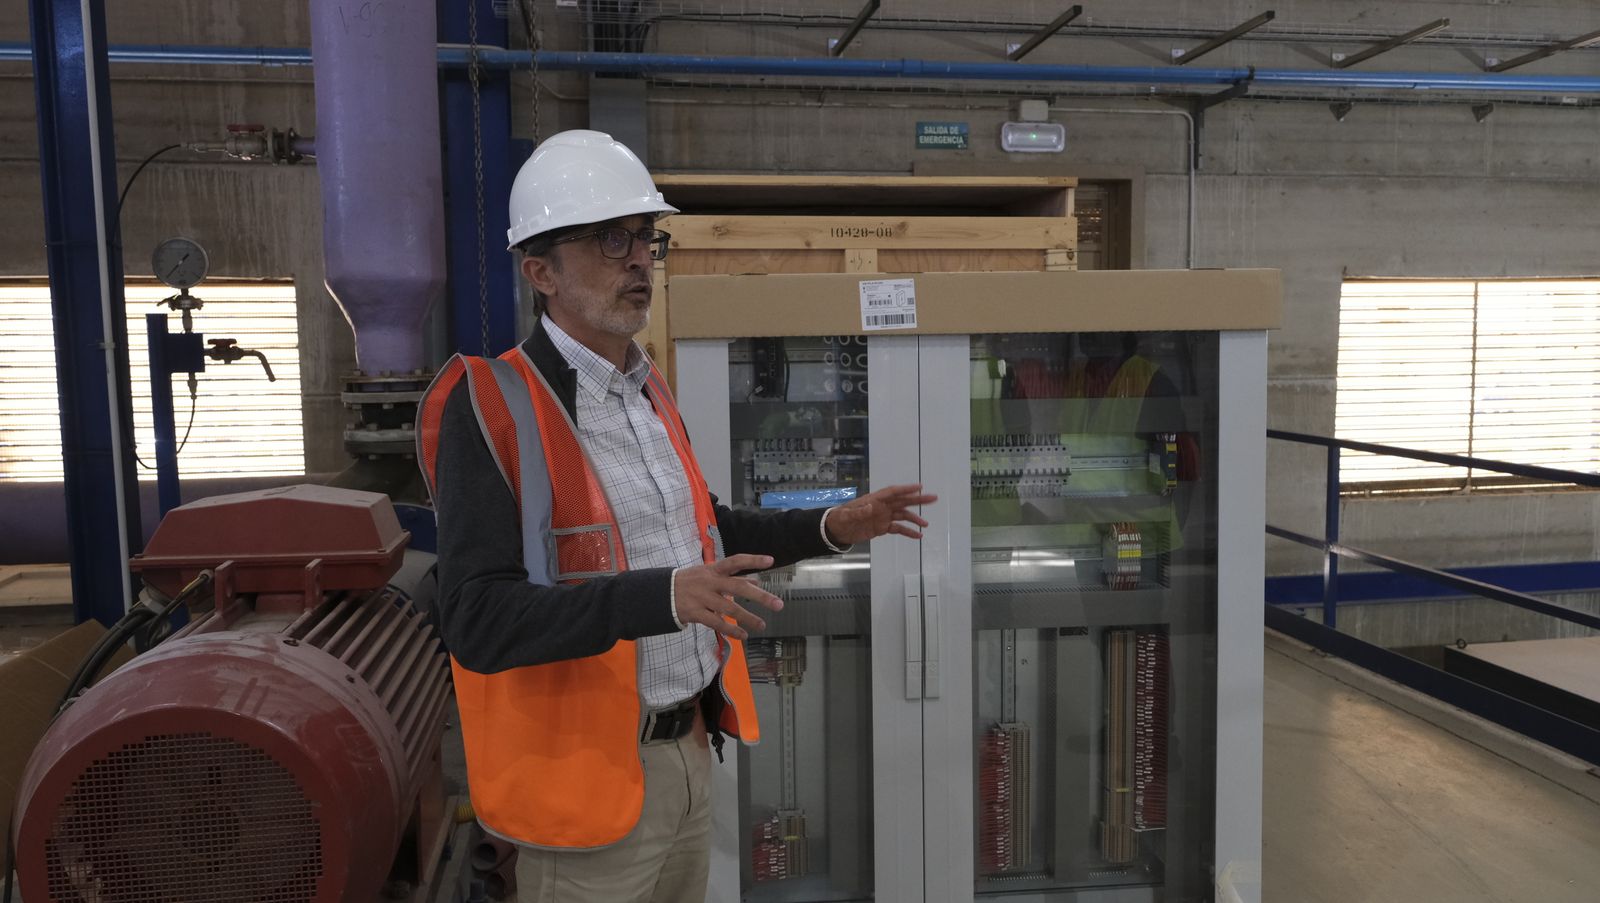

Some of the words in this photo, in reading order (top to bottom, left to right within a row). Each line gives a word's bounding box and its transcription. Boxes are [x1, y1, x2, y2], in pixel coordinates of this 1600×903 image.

[923, 125, 948, 135] SALIDA
[949, 125, 960, 135] DE
[919, 135, 964, 145] EMERGENCIA
[830, 227, 892, 238] 10428-08
